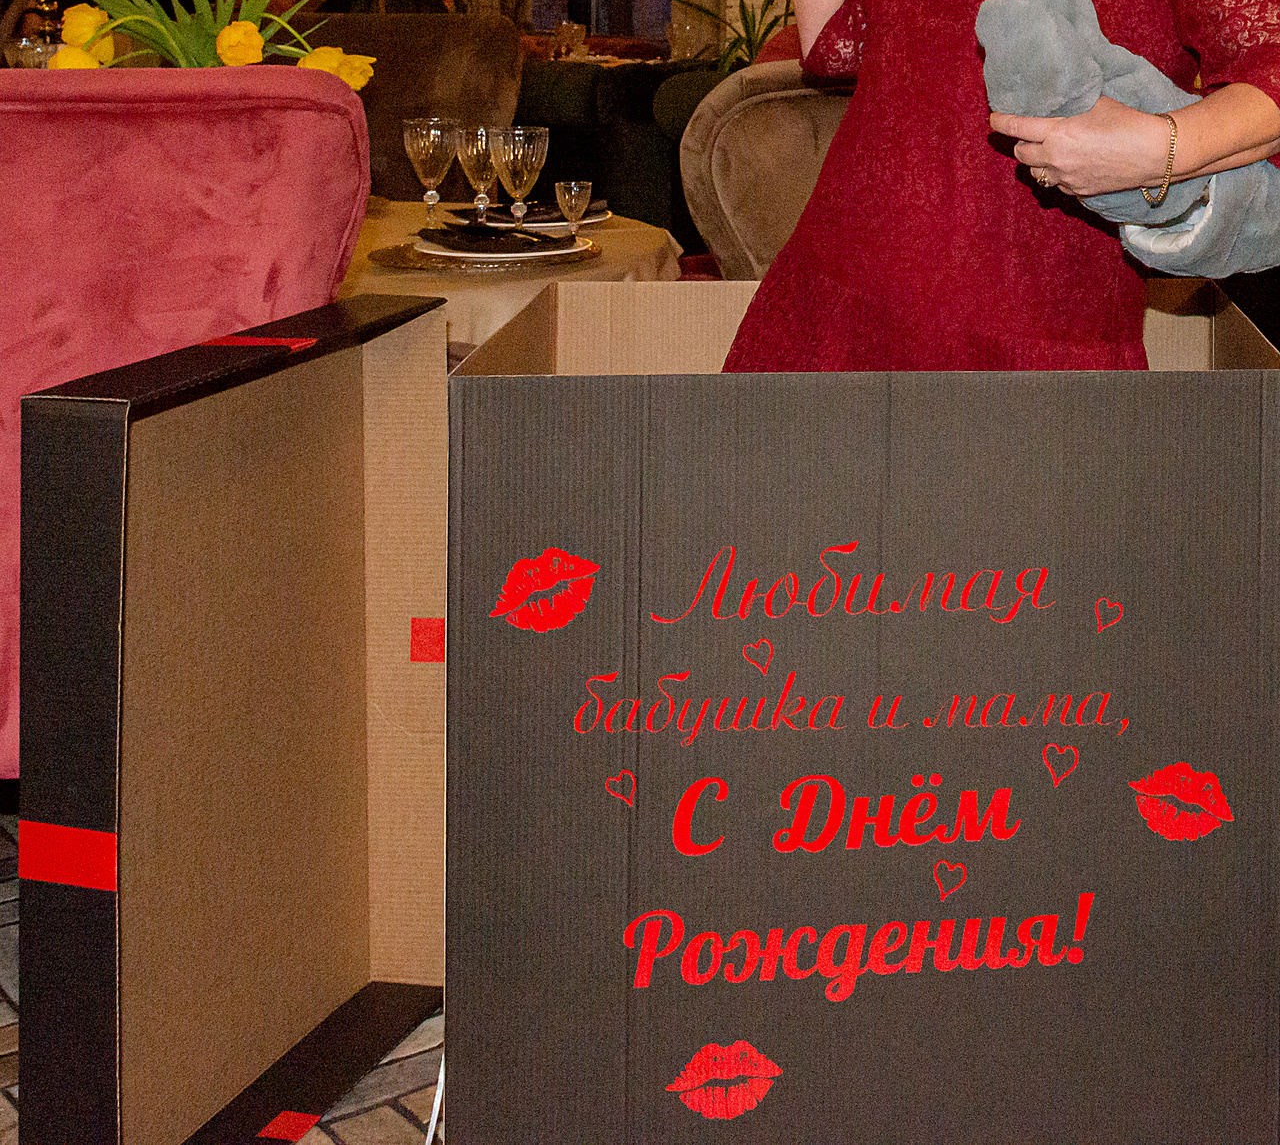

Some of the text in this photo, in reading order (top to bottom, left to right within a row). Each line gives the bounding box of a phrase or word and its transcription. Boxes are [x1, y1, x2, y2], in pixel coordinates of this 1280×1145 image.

[650, 539, 1057, 624] Любимая
[573, 669, 1130, 746] бабушка и мама,
[672, 772, 1023, 857] С Днём
[623, 891, 1095, 1003] Рождения!
